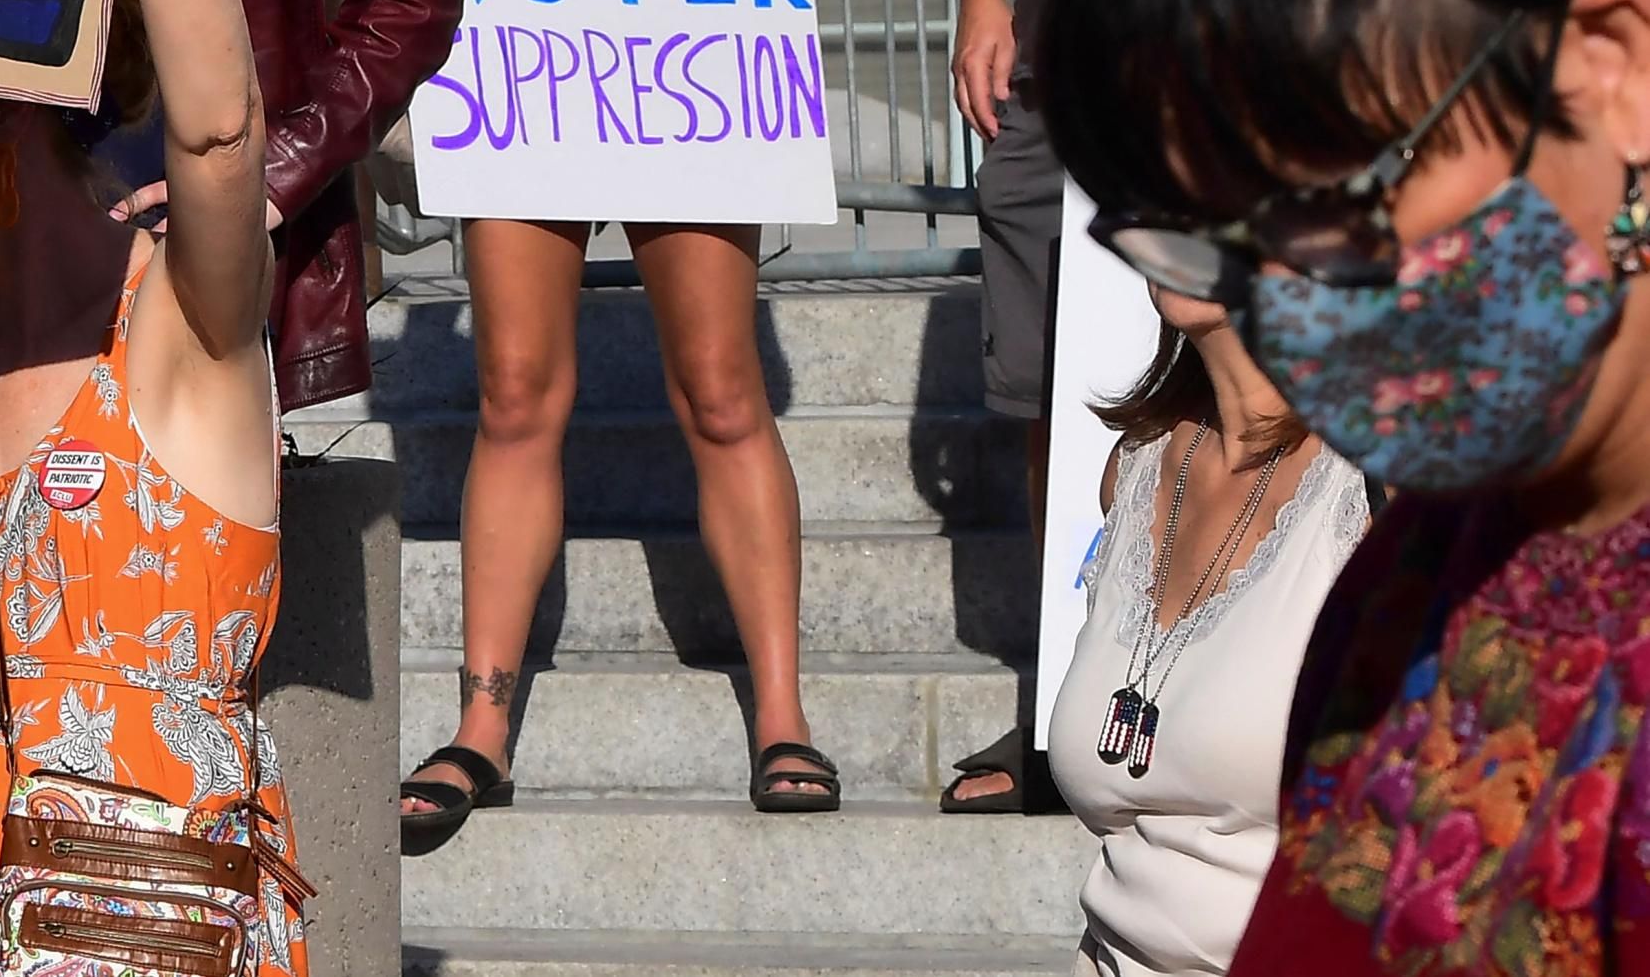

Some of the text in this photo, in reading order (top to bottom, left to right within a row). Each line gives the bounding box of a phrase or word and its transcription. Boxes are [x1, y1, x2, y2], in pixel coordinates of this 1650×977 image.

[426, 25, 827, 151] SUPPRESSION
[51, 454, 102, 465] DISSENT IS
[48, 473, 94, 484] PATRIOTIC
